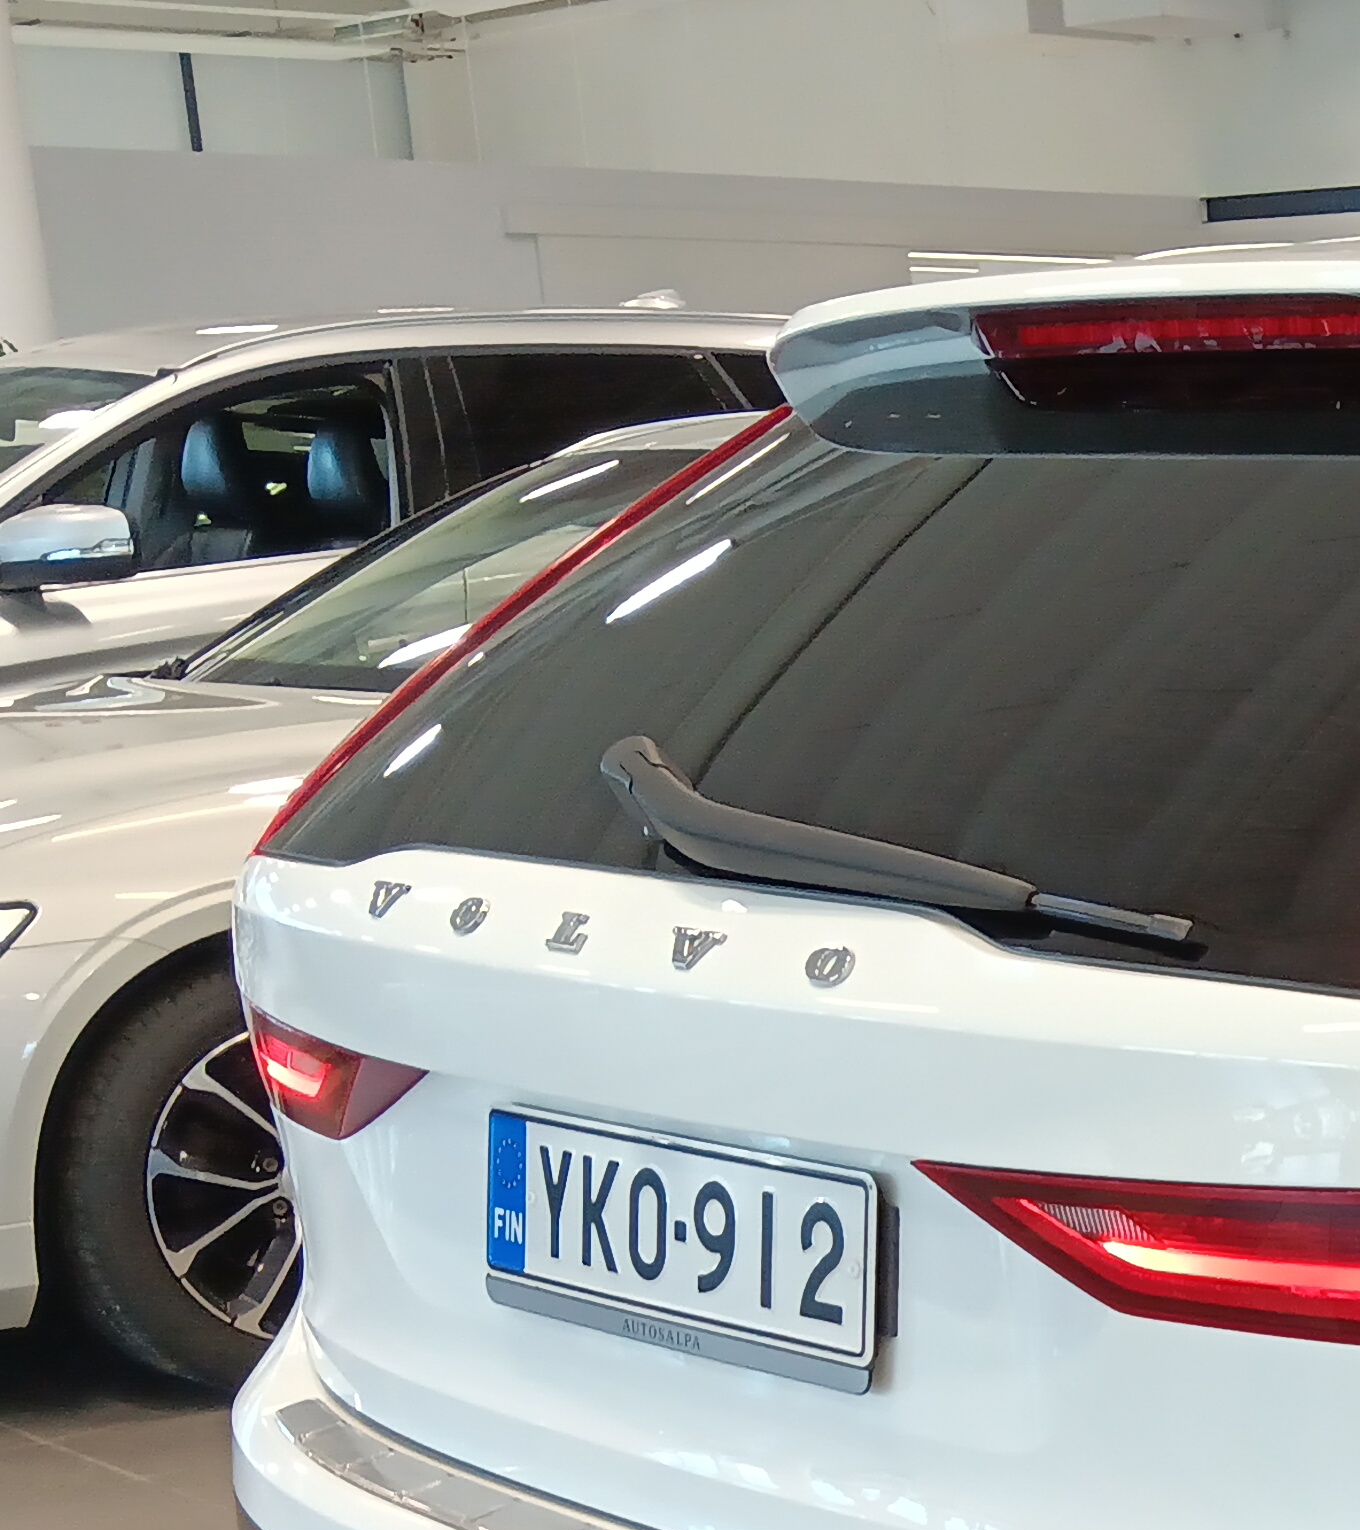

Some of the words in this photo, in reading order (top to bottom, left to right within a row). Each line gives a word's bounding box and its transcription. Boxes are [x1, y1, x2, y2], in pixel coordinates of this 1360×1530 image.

[369, 879, 857, 988] VOLVO
[493, 1206, 524, 1245] FIN
[622, 1318, 701, 1350] AUTOSALPA
